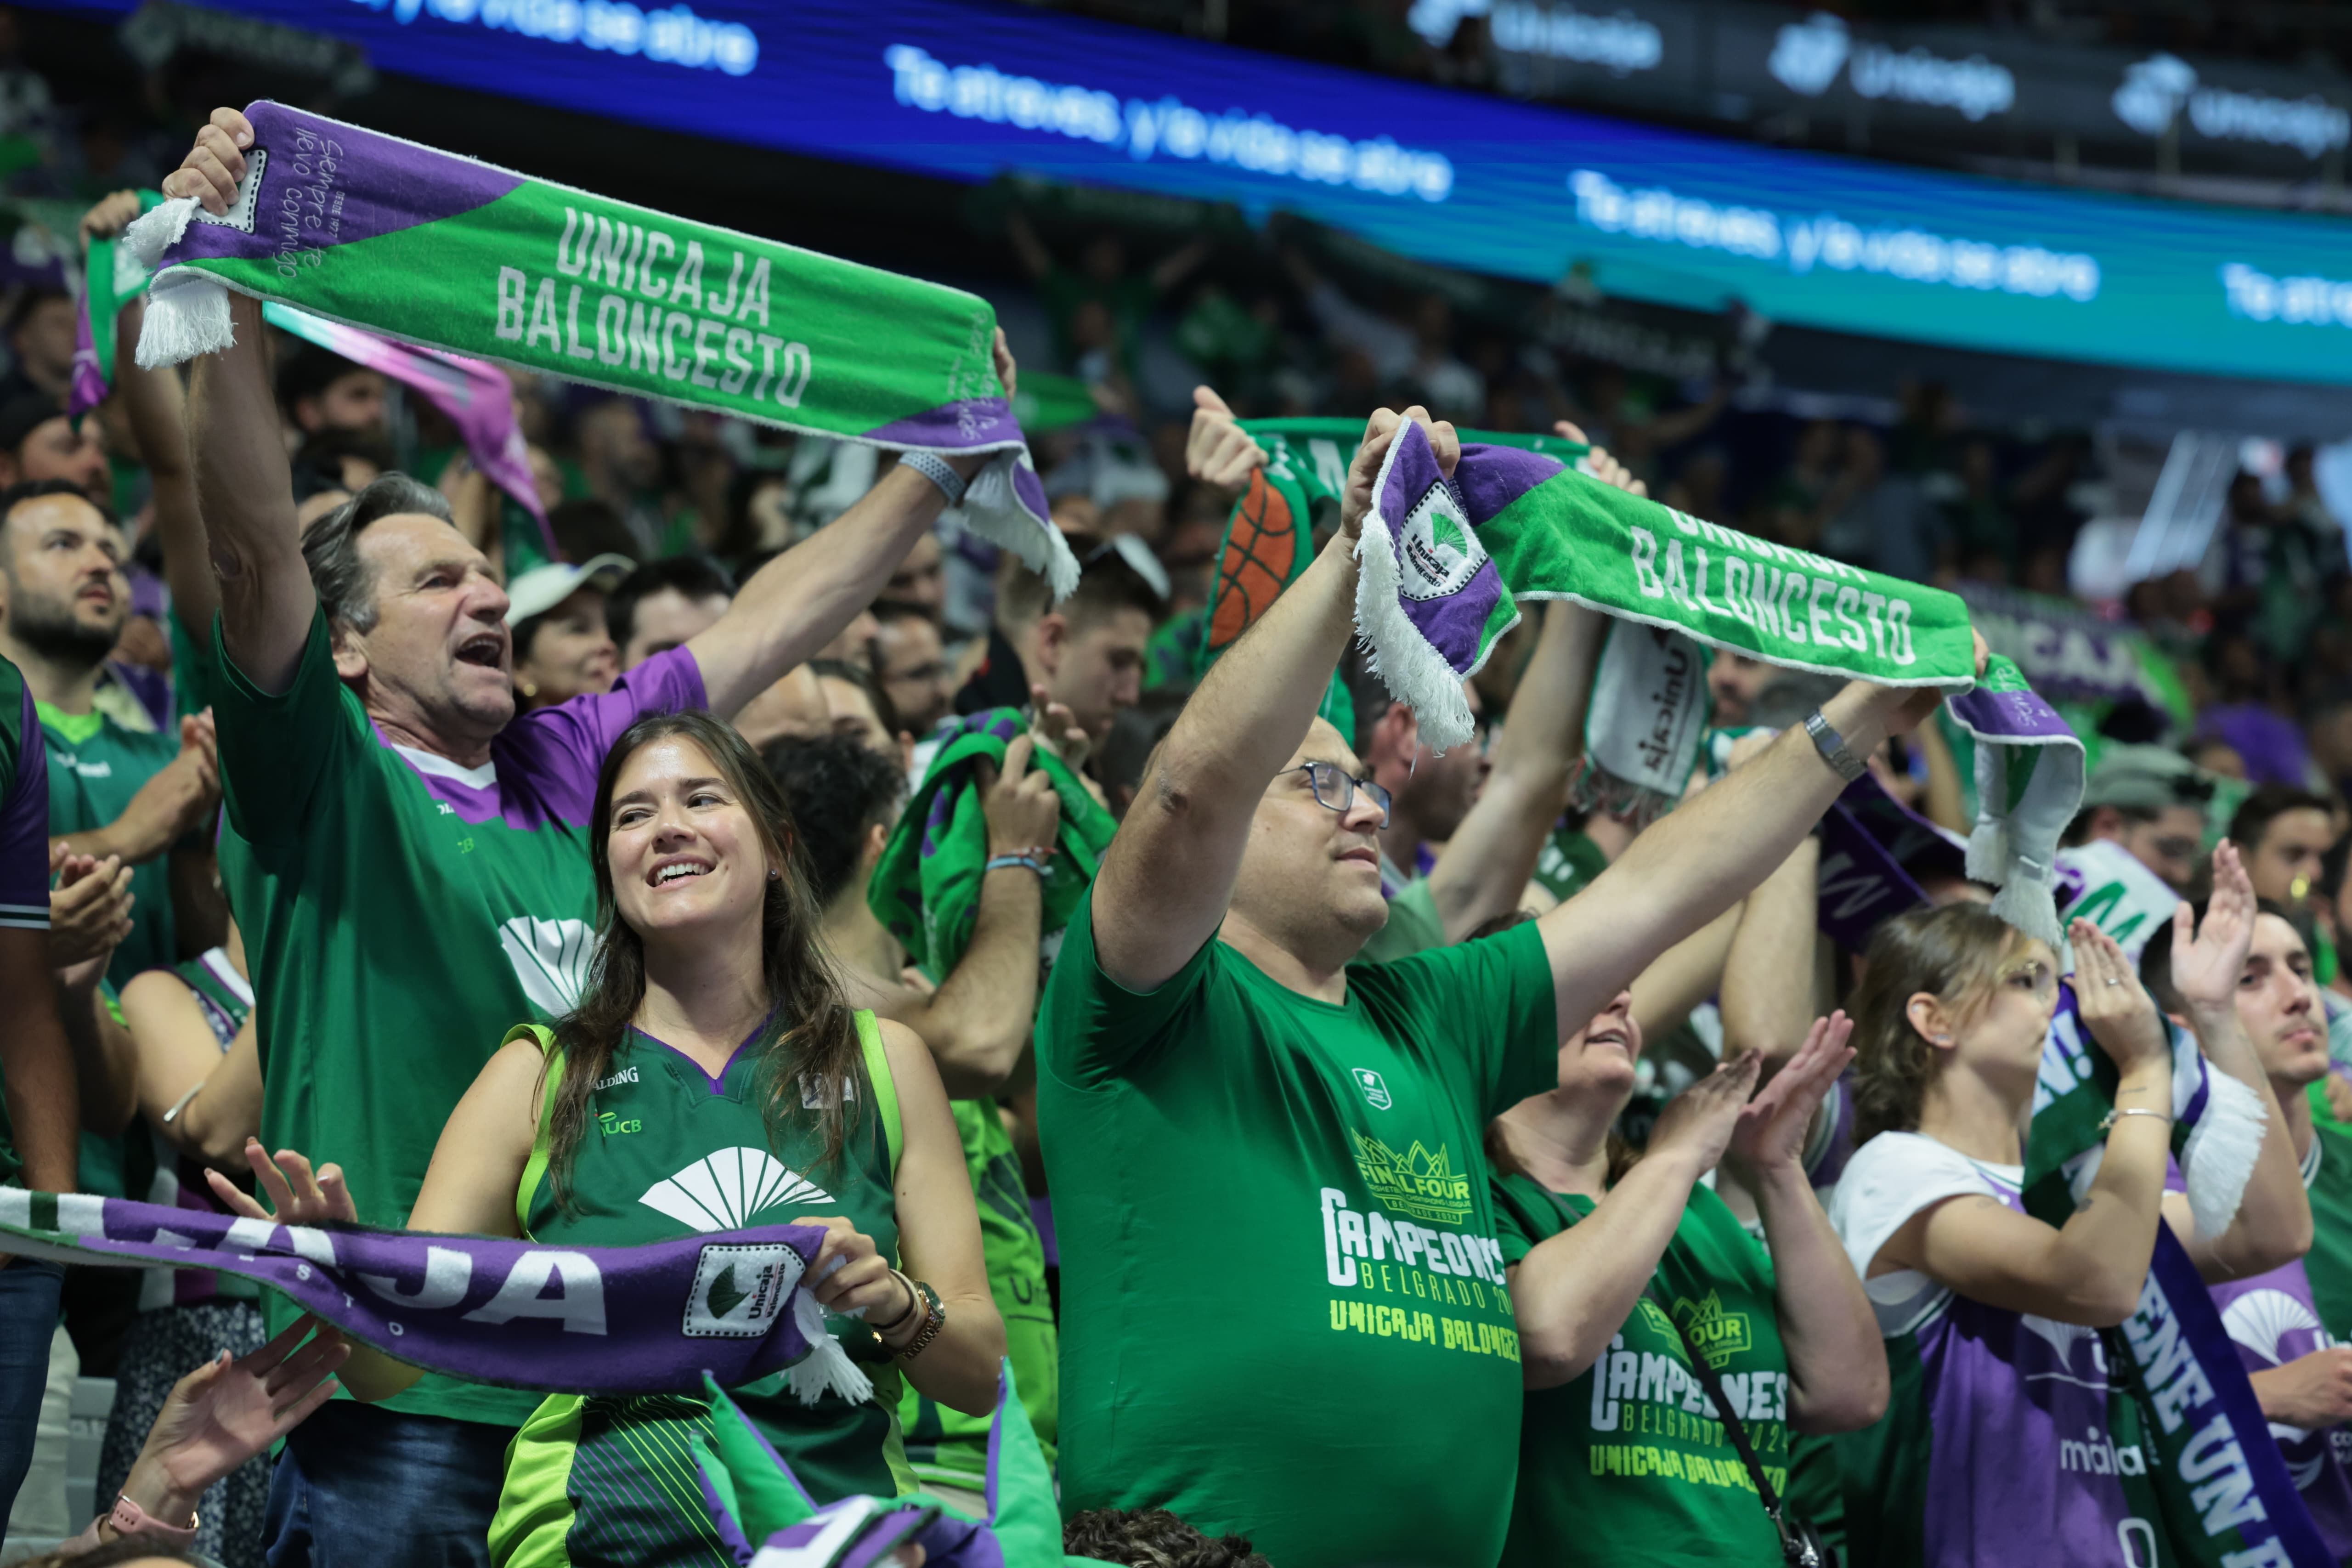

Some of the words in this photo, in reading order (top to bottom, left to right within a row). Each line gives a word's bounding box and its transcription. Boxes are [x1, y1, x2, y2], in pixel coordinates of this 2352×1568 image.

[332, 191, 345, 215] DESDE
[273, 187, 302, 277] conmigo
[328, 218, 340, 238] 1977
[304, 246, 327, 267] te
[556, 207, 771, 327] UNICAJA
[496, 266, 811, 408] BALONCESTO
[1411, 533, 1450, 577] Unicaja
[1630, 525, 1917, 666] BALONCESTO
[605, 1119, 642, 1134] UCB
[1414, 1178, 1470, 1200] FOUR
[747, 1264, 774, 1319] Unicaja
[1361, 1262, 1486, 1308] BELGRADO
[1330, 1300, 1436, 1345] UNICAJA
[1623, 1404, 1725, 1448] BELGRADO
[1590, 1444, 1685, 1480] UNICAJA
